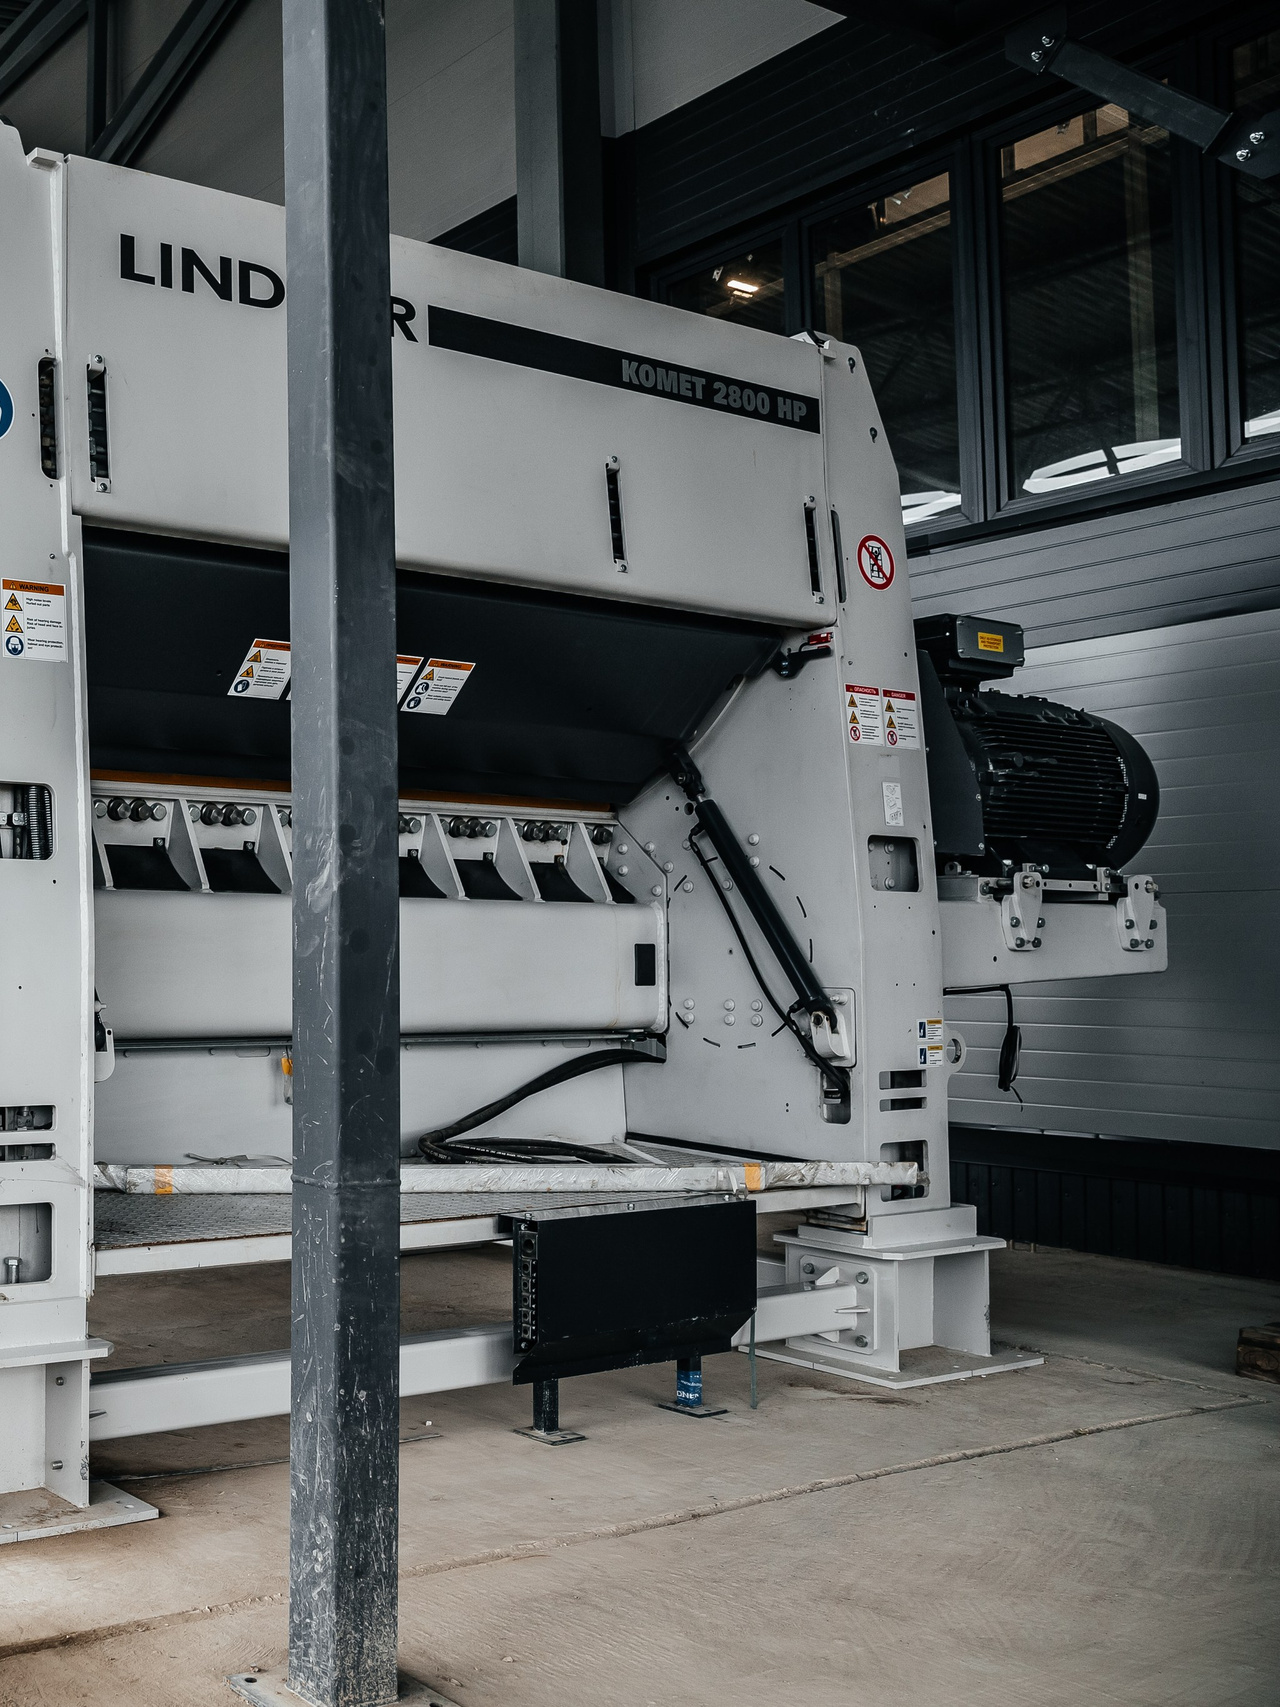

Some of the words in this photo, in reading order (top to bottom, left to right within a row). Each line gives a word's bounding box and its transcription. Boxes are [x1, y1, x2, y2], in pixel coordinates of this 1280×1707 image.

[119, 233, 419, 343] LINDR
[621, 358, 706, 400] KOMET
[713, 381, 770, 415] 2800
[777, 396, 807, 423] HP
[19, 583, 50, 592] WARNING
